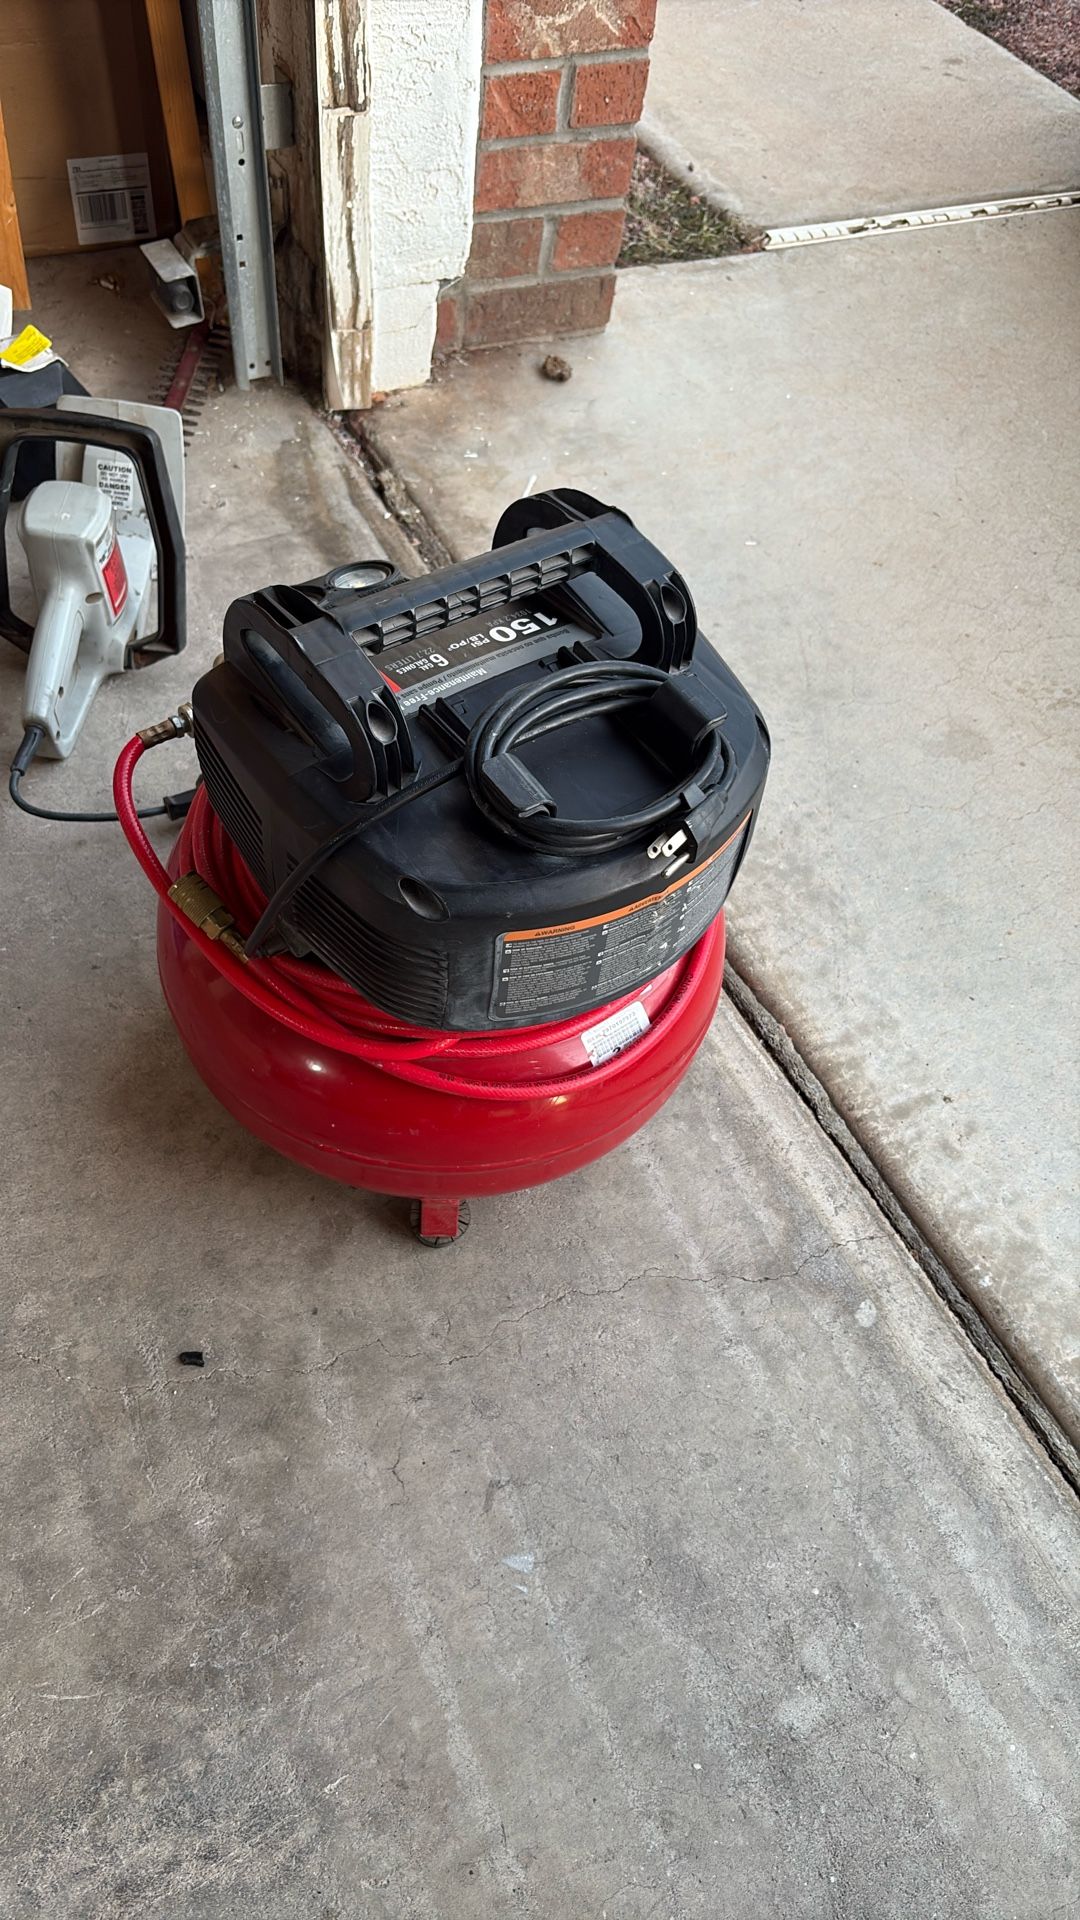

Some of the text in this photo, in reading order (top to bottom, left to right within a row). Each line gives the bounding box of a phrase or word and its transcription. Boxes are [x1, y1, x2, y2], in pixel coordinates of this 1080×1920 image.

[97, 463, 132, 474] CAUTION
[98, 481, 131, 491] DANGER
[470, 611, 558, 648] 150 PSI
[496, 643, 525, 659] necesita
[384, 655, 415, 672] LITERS
[418, 653, 449, 672] 6 GAL
[402, 666, 488, 708] Maintenance-Free
[417, 677, 443, 692] Pompe
[541, 925, 576, 937] WARNING
